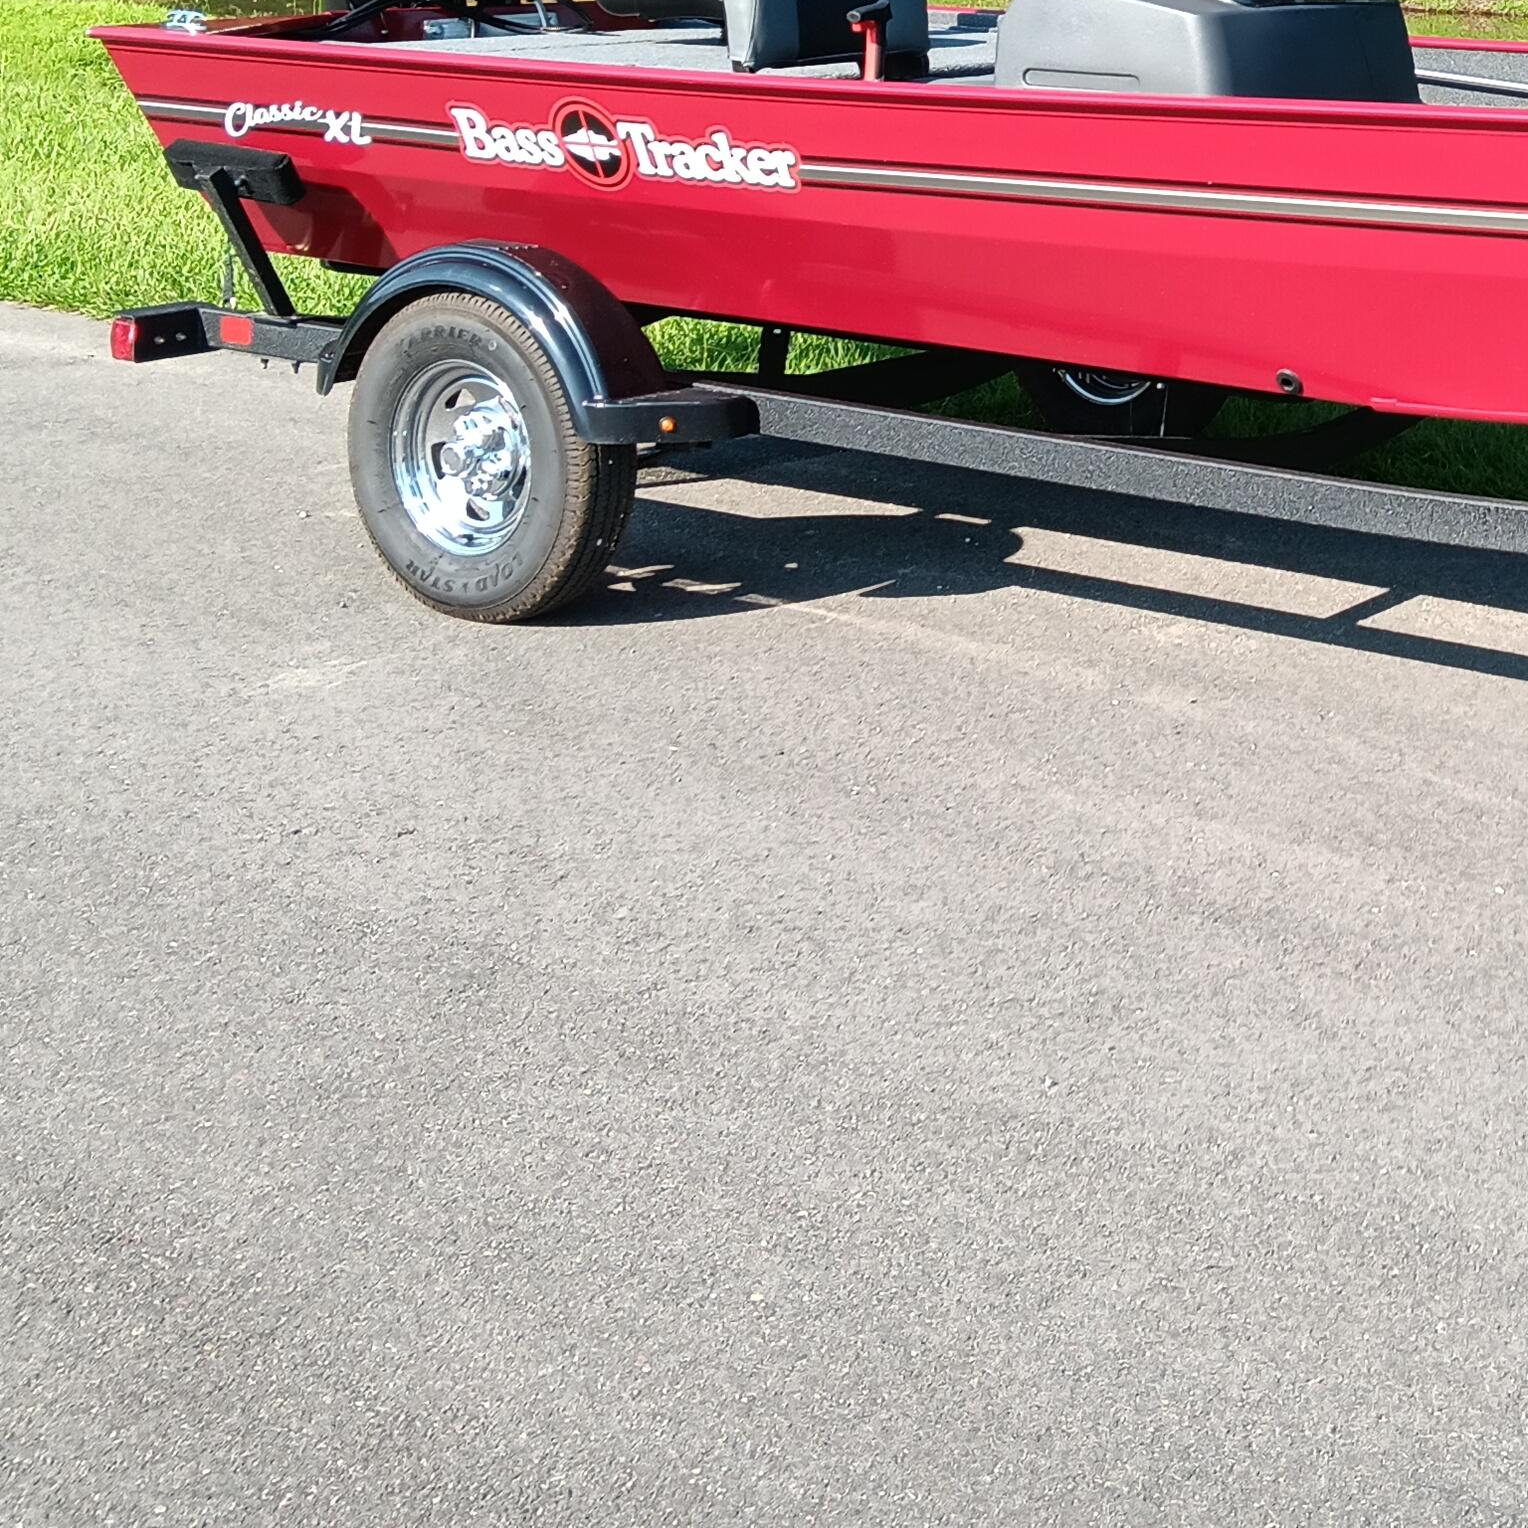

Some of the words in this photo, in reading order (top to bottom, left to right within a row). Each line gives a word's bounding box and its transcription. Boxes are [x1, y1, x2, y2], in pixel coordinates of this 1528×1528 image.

[224, 101, 323, 137] Classic
[318, 110, 372, 145] XL
[450, 107, 565, 166] Bass
[616, 120, 797, 189] Tracker
